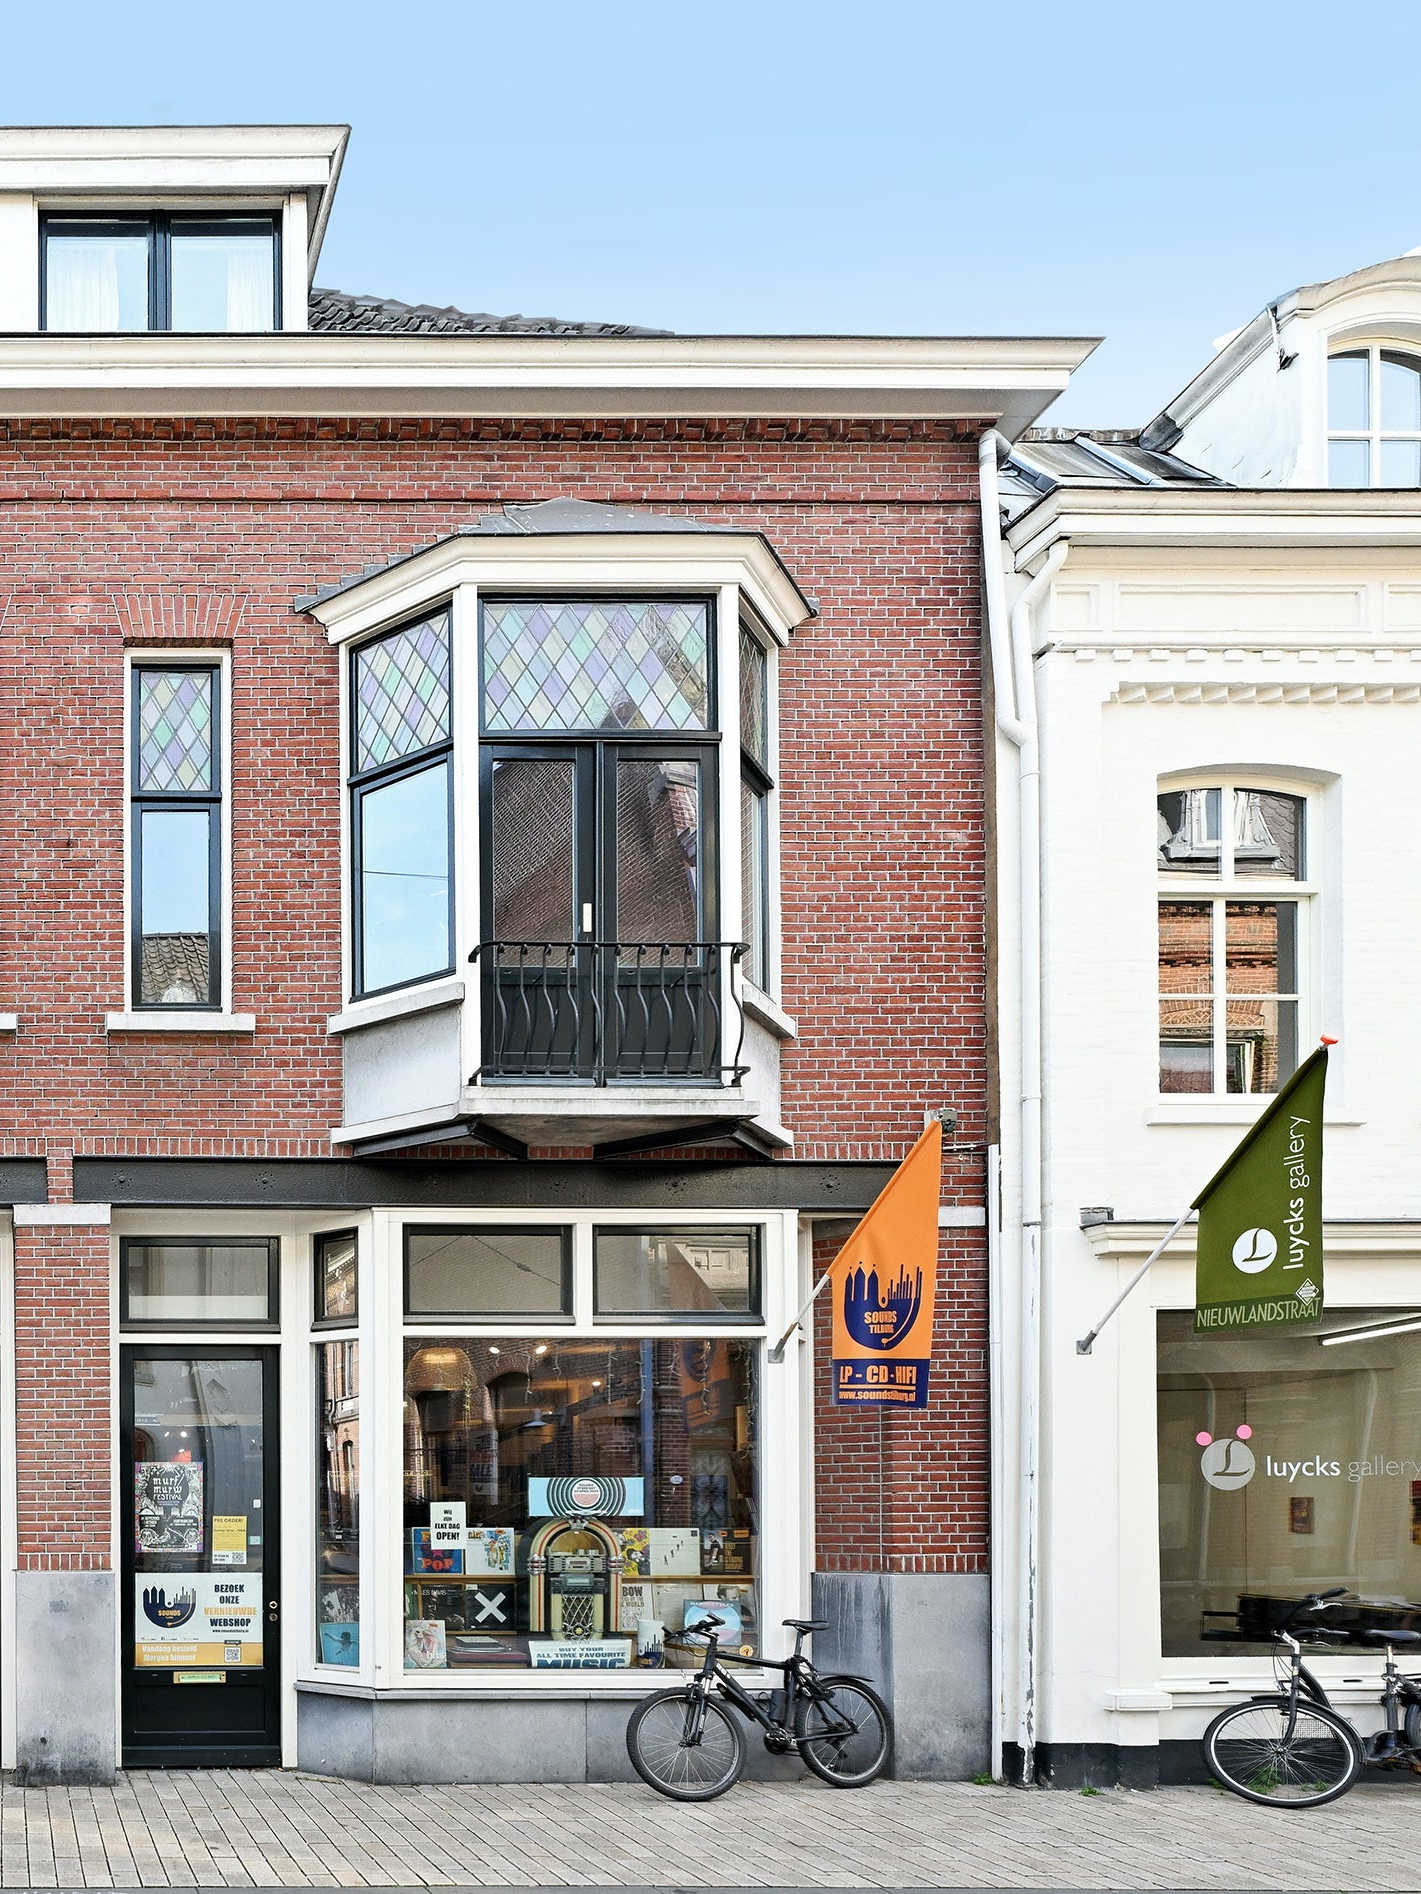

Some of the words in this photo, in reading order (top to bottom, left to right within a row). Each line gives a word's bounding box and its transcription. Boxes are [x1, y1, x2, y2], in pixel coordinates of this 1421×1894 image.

[1283, 1115, 1311, 1190] gallery
[1283, 1197, 1310, 1270] luycks
[864, 1311, 898, 1324] SOUNDS
[1196, 1297, 1322, 1328] NIEUWLANDSTRAAT
[840, 1365, 853, 1383] LP
[866, 1365, 888, 1384] CD
[895, 1365, 917, 1385] HIFI
[1266, 1455, 1341, 1484] luycks
[1347, 1454, 1421, 1483] gallery
[153, 1493, 183, 1501] FESTIVAL
[436, 1531, 460, 1540] OPEN!
[421, 1557, 454, 1571] POP
[214, 1584, 245, 1593] BEZOEK
[219, 1596, 240, 1605] ONZE
[203, 1607, 258, 1616] VERNIEUWDE
[209, 1618, 251, 1627] WEBSHOP
[537, 1658, 626, 1669] MUSIC
